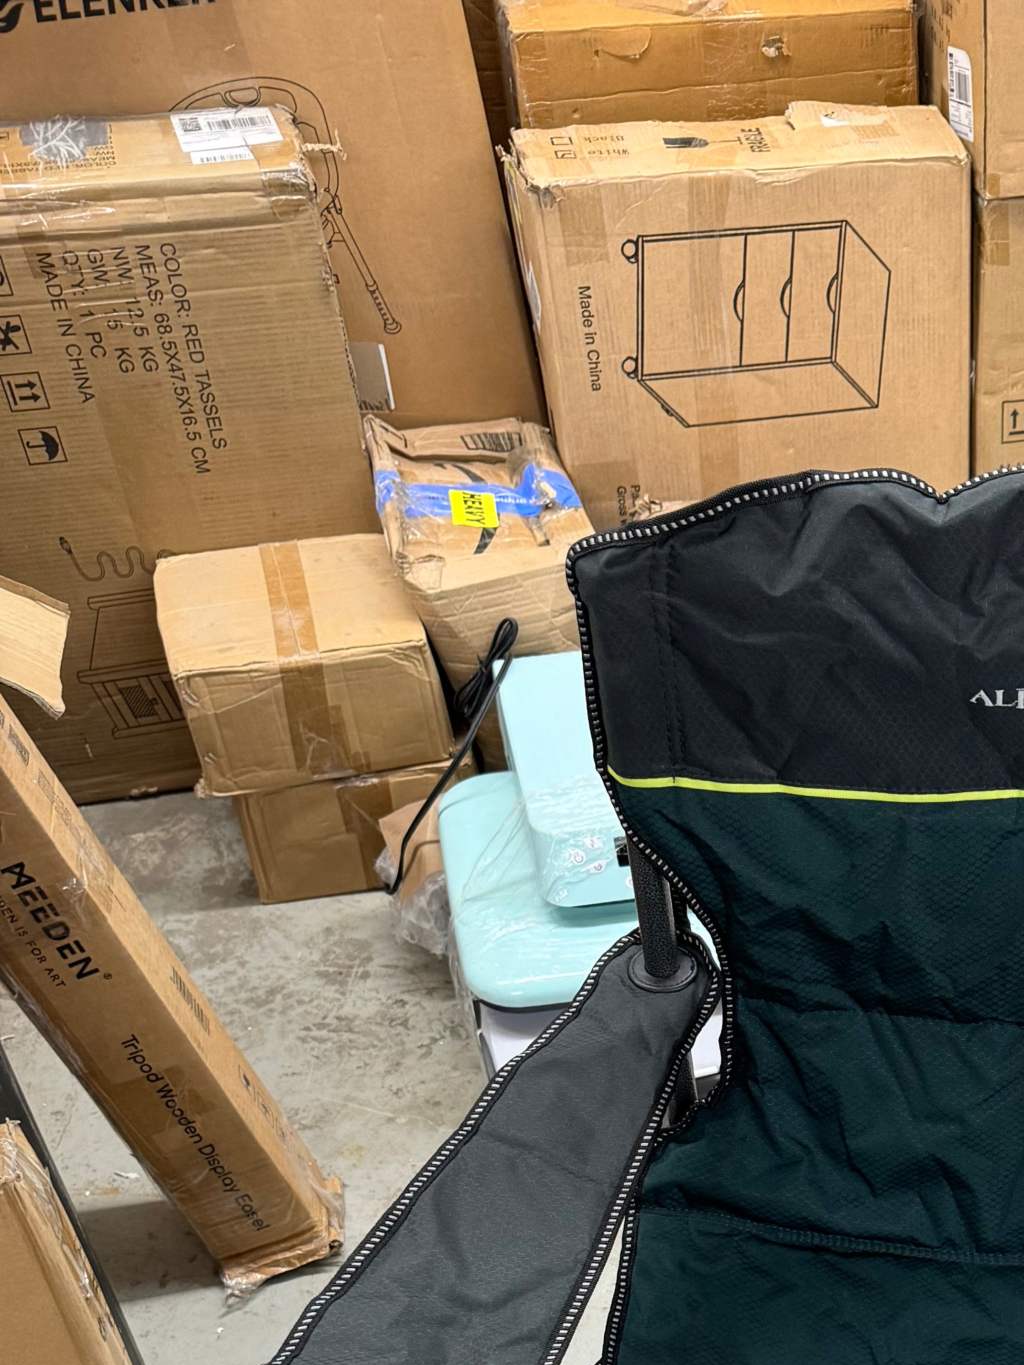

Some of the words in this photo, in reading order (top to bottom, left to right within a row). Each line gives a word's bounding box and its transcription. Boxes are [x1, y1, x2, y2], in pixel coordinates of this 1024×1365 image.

[36, 252, 68, 311] MADE
[62, 251, 88, 296] QTY:
[57, 318, 77, 337] IN
[80, 310, 95, 318] 1
[578, 285, 595, 328] Made
[86, 331, 107, 358] PC
[135, 244, 164, 307] MEAS:
[154, 312, 202, 441] 68.5X47.5X16.5
[191, 447, 210, 474] CM
[138, 346, 159, 373] KG
[160, 242, 192, 318] COLOR:
[182, 323, 205, 364] RED
[195, 369, 227, 449] TASSELS
[584, 332, 597, 345] in
[65, 343, 96, 403] CHINA
[114, 347, 135, 374] KG
[587, 349, 602, 392] China
[463, 491, 486, 526] HEAVY
[15, 926, 28, 937] IS
[25, 940, 47, 964] FOR
[44, 967, 66, 987] ART
[121, 1034, 164, 1083] Tripod
[156, 1083, 203, 1144] Wooden
[198, 1143, 240, 1193] Display
[234, 1194, 270, 1231] Easel
